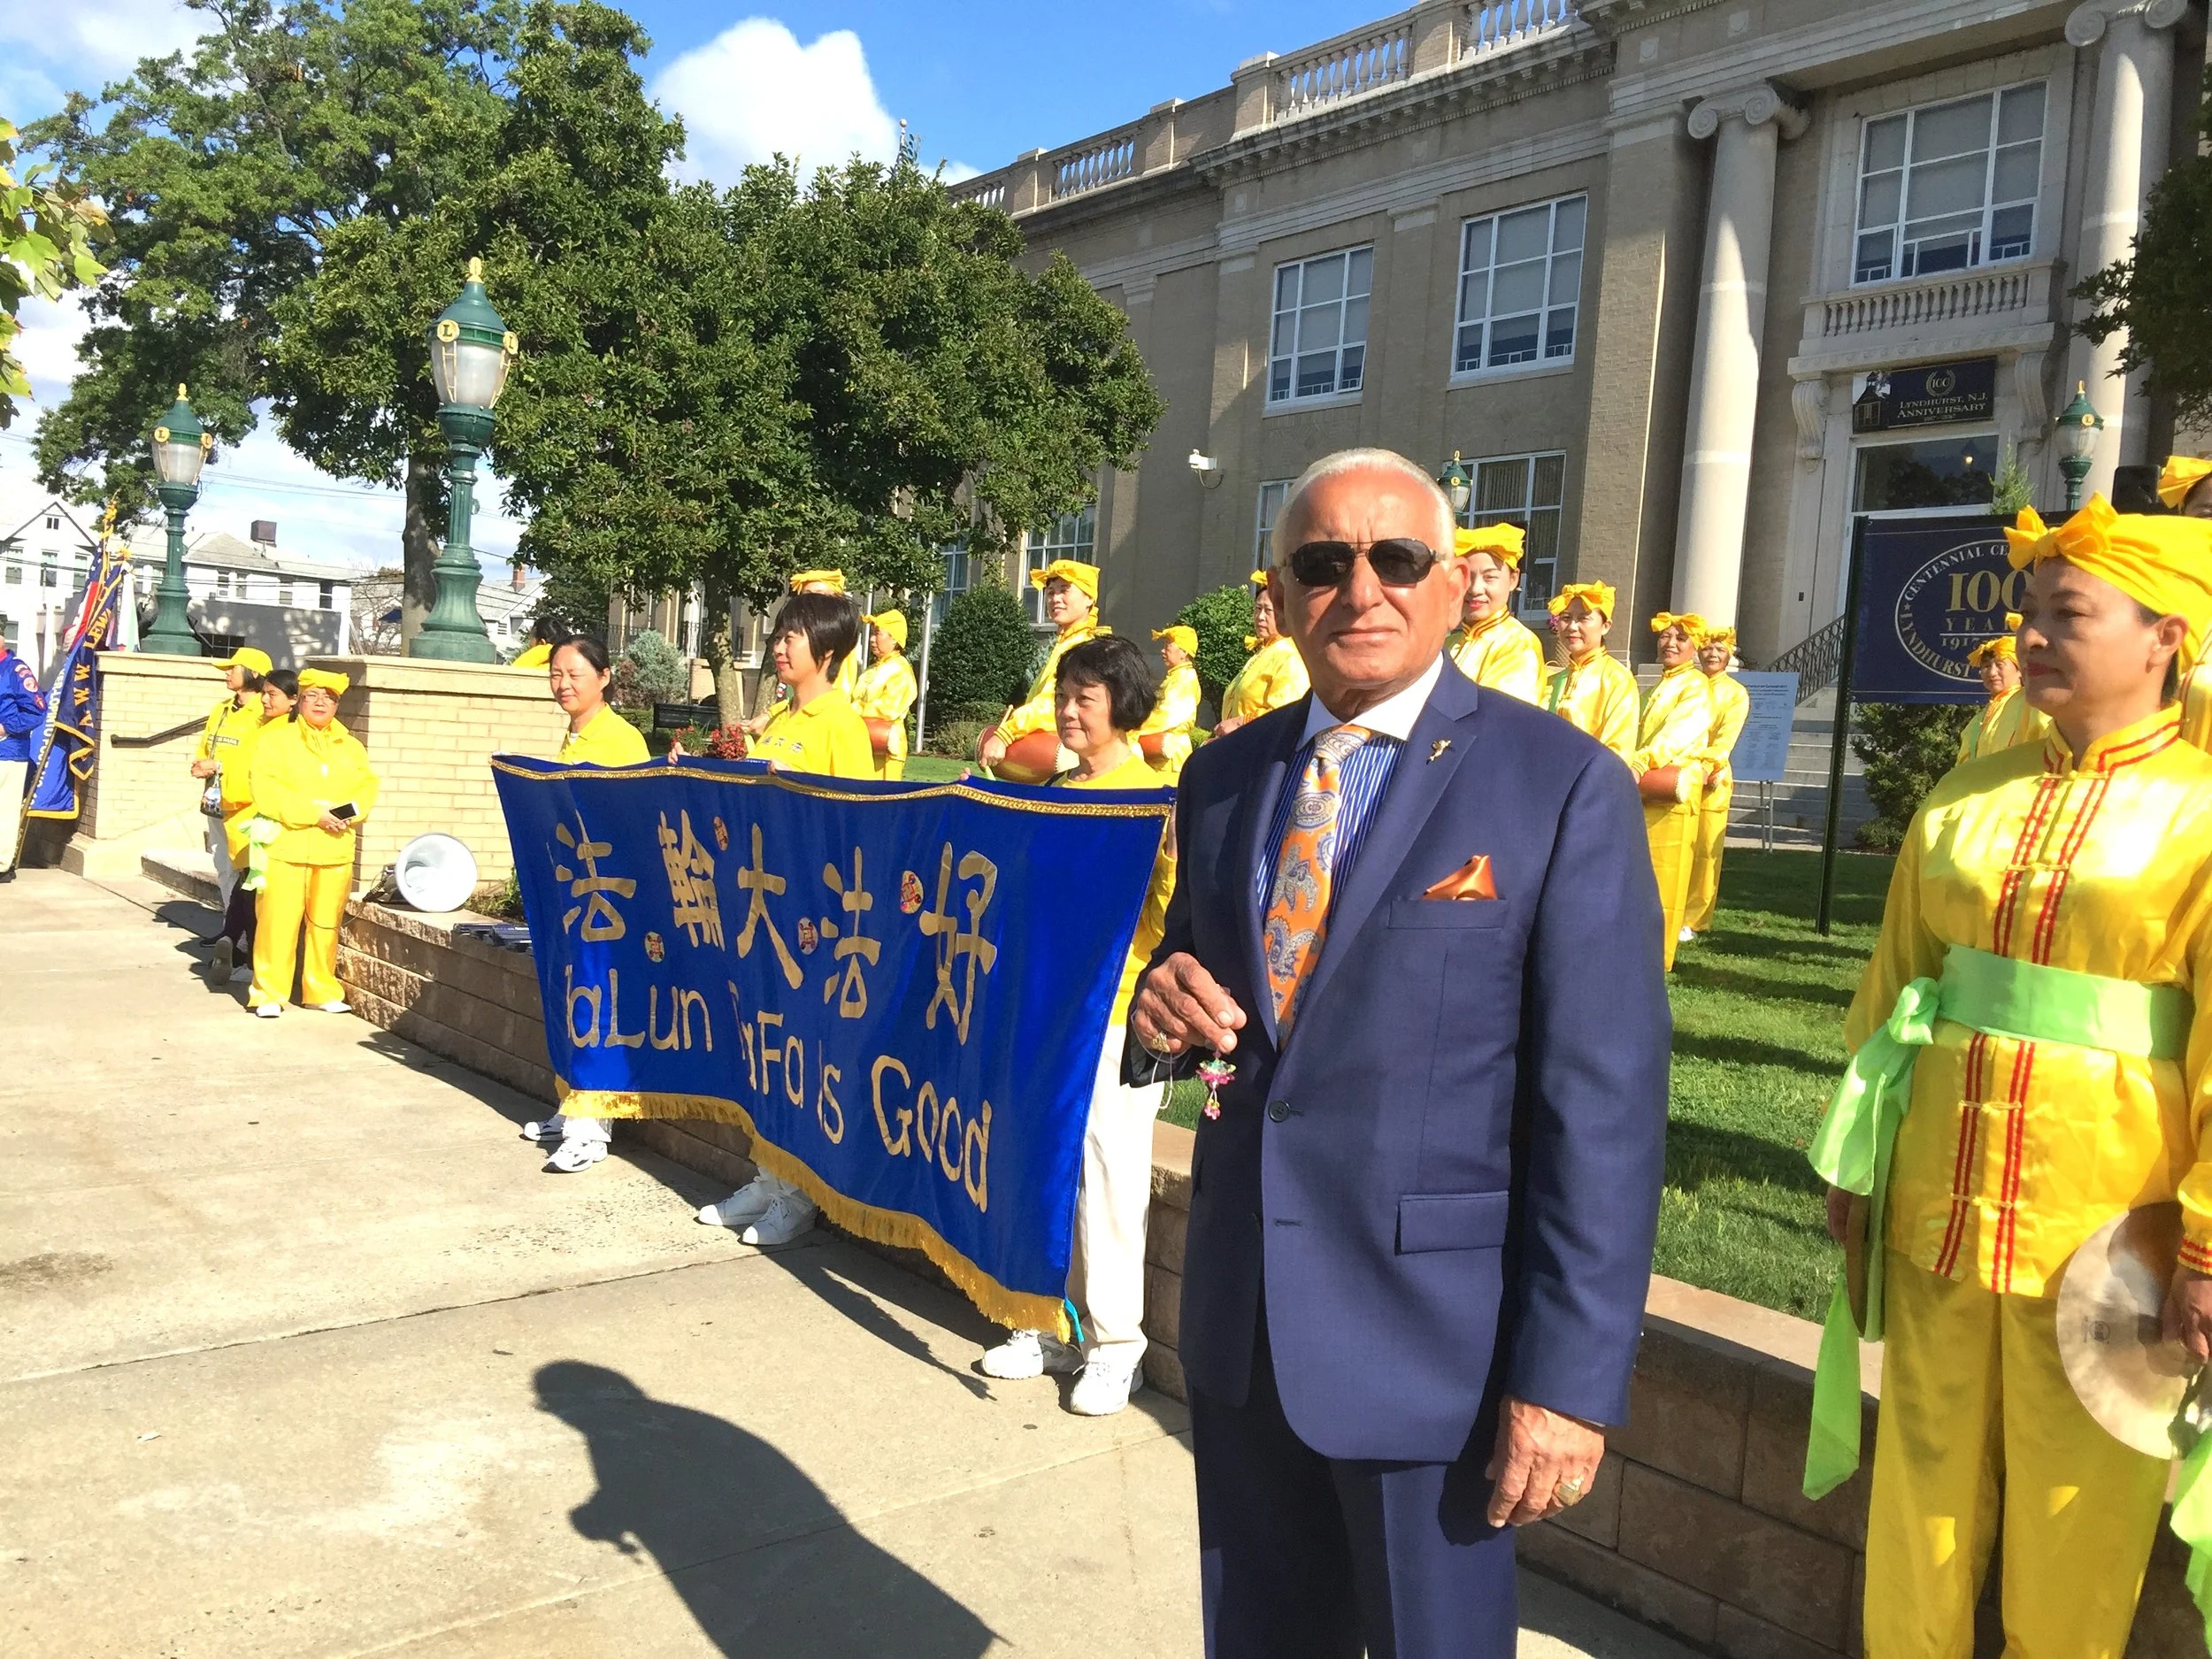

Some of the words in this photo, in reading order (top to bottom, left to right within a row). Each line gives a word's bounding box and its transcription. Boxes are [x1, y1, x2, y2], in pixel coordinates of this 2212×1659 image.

[1897, 403, 1986, 419] ANNIVERSARY
[1904, 547, 1985, 602] CENTENNIAL
[1945, 570, 2033, 613] 100
[1901, 612, 1971, 678] LYNDHURST
[555, 808, 998, 1046] 法輪大法好
[871, 1055, 993, 1213] Good
